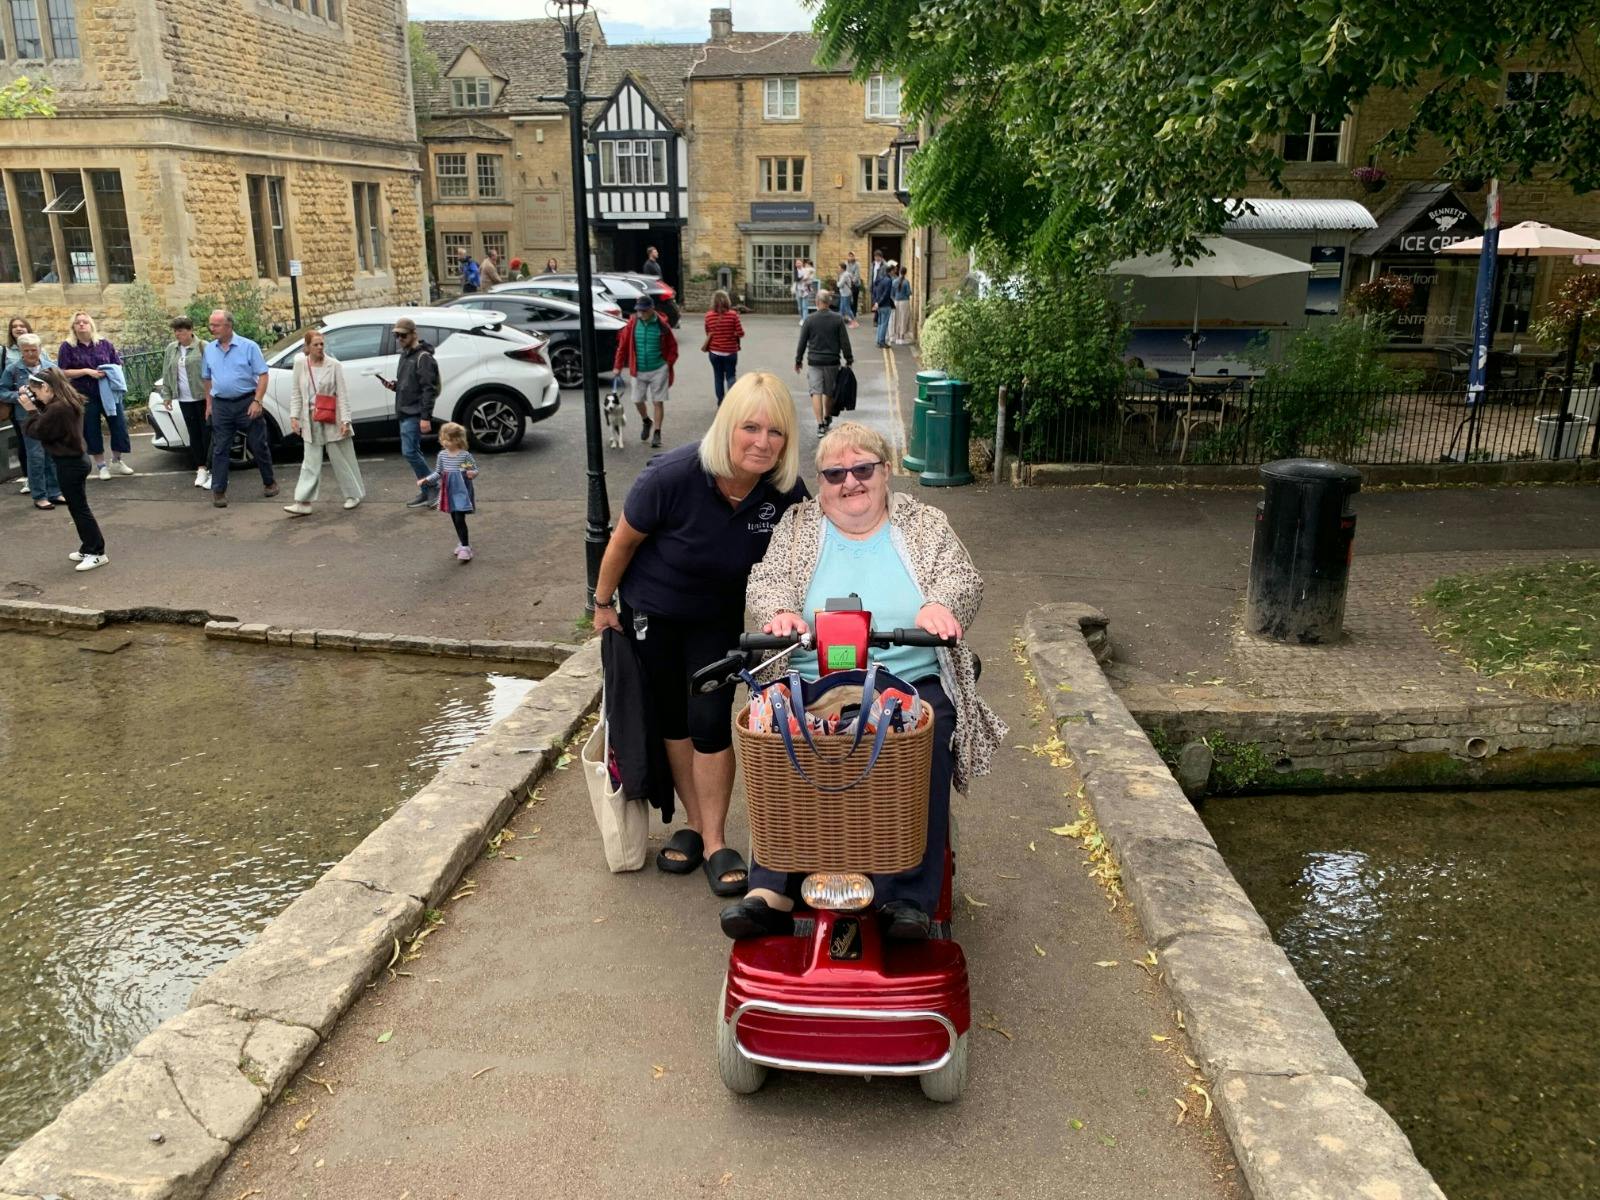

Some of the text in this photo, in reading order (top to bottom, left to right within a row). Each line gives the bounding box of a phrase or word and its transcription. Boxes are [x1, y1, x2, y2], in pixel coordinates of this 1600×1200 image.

[1428, 207, 1467, 220] BENNETTS
[1400, 236, 1471, 251] ICE CRE
[1398, 314, 1457, 325] ENTRANCE
